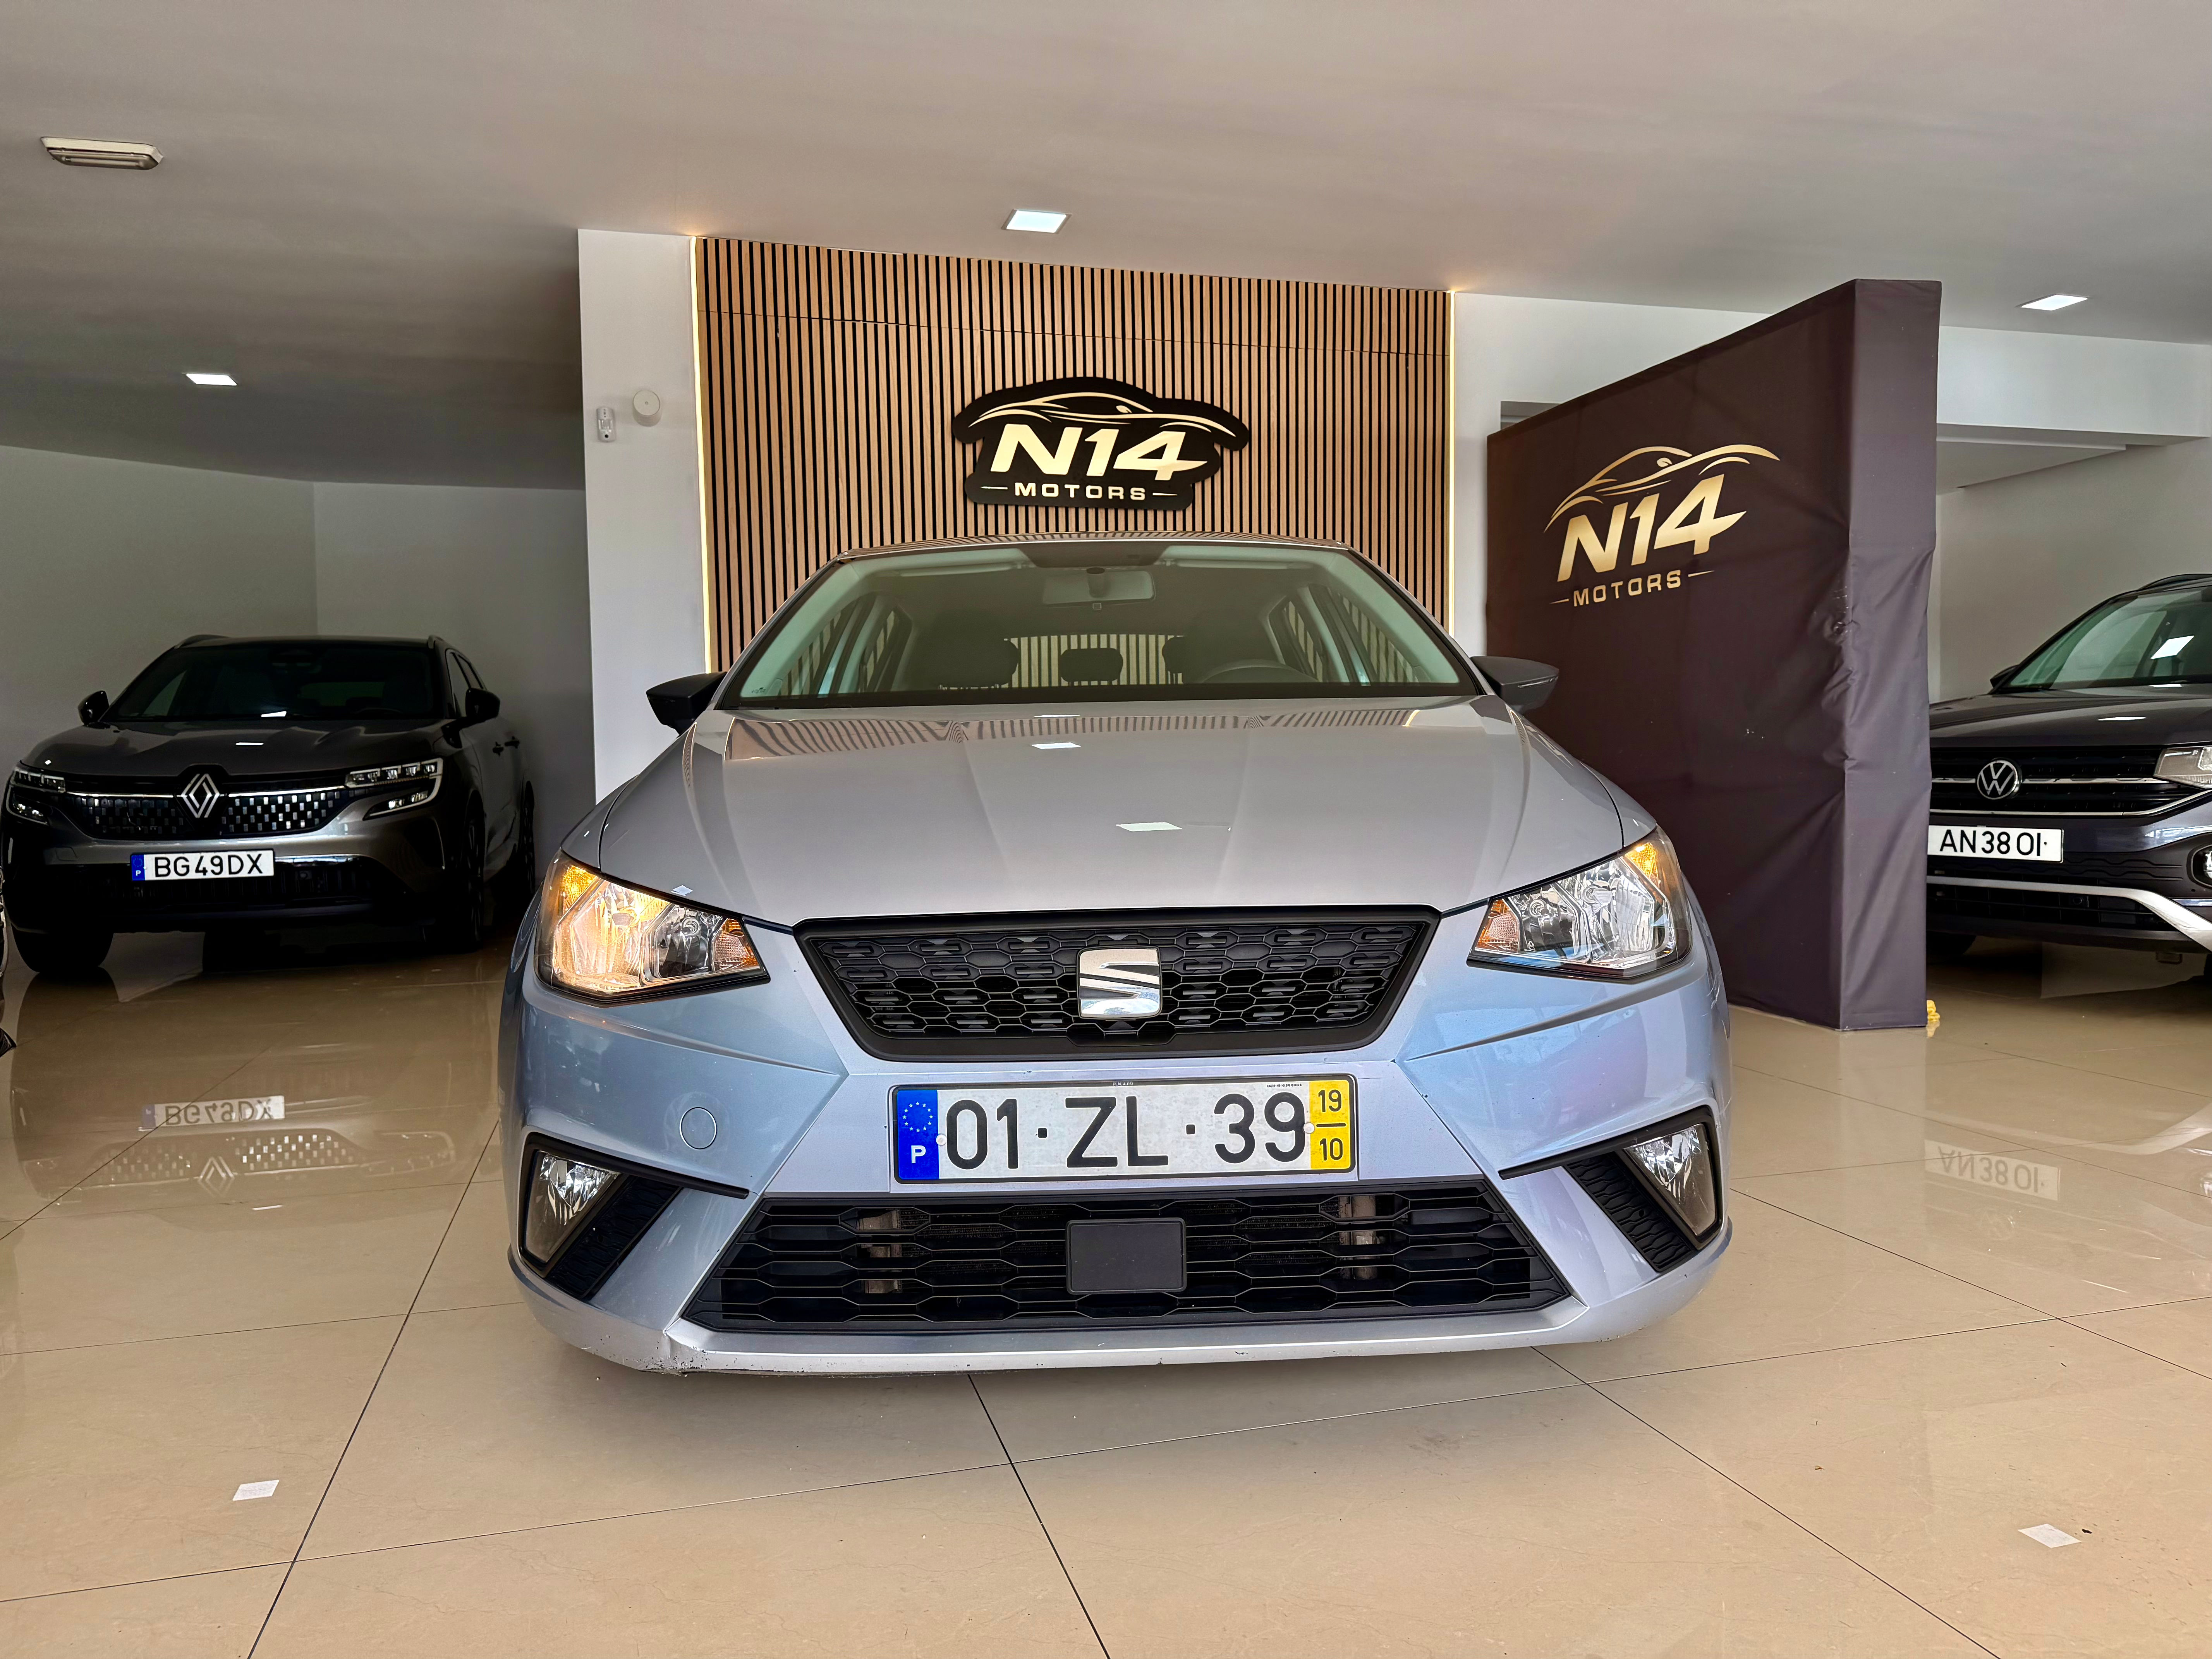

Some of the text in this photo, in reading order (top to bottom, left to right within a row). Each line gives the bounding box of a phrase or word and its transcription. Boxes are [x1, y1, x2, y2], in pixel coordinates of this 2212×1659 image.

[990, 423, 1208, 481] N14
[1015, 482, 1146, 501] MOTORS
[1557, 474, 1747, 582] N14
[1573, 569, 1681, 607] MOTORS
[1318, 1089, 1342, 1112] 19
[911, 1145, 926, 1164] P
[1319, 1138, 1343, 1161] 10
